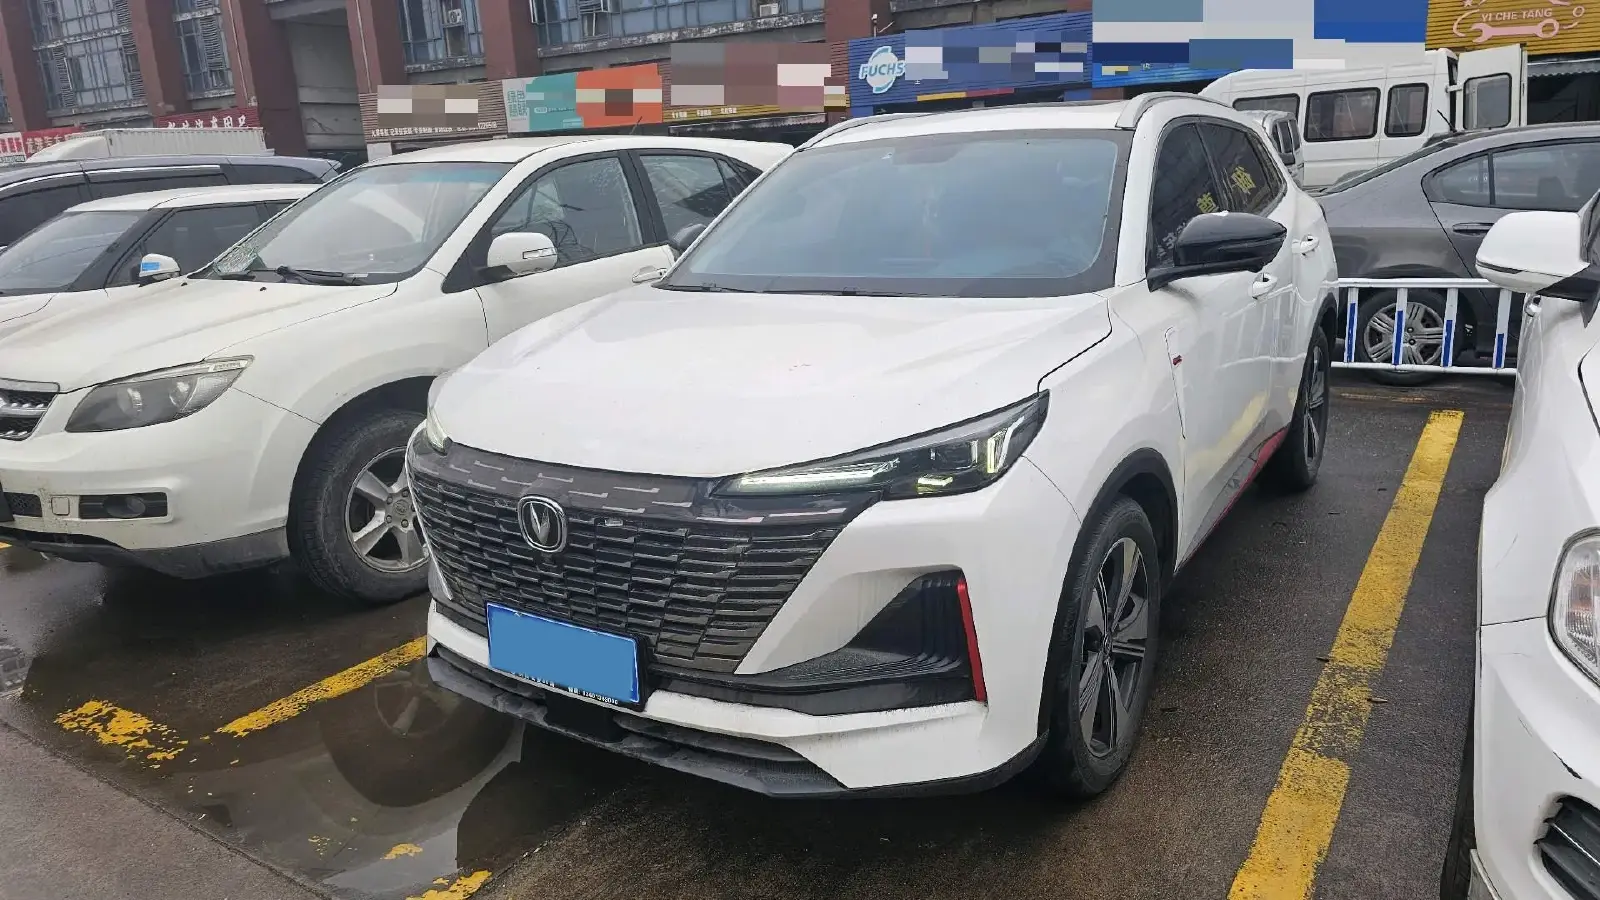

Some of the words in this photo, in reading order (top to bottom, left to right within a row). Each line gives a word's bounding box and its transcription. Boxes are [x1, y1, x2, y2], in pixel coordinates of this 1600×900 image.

[1495, 12, 1517, 20] CHE
[1522, 8, 1553, 19] TANG
[860, 61, 904, 78] FUCHS
